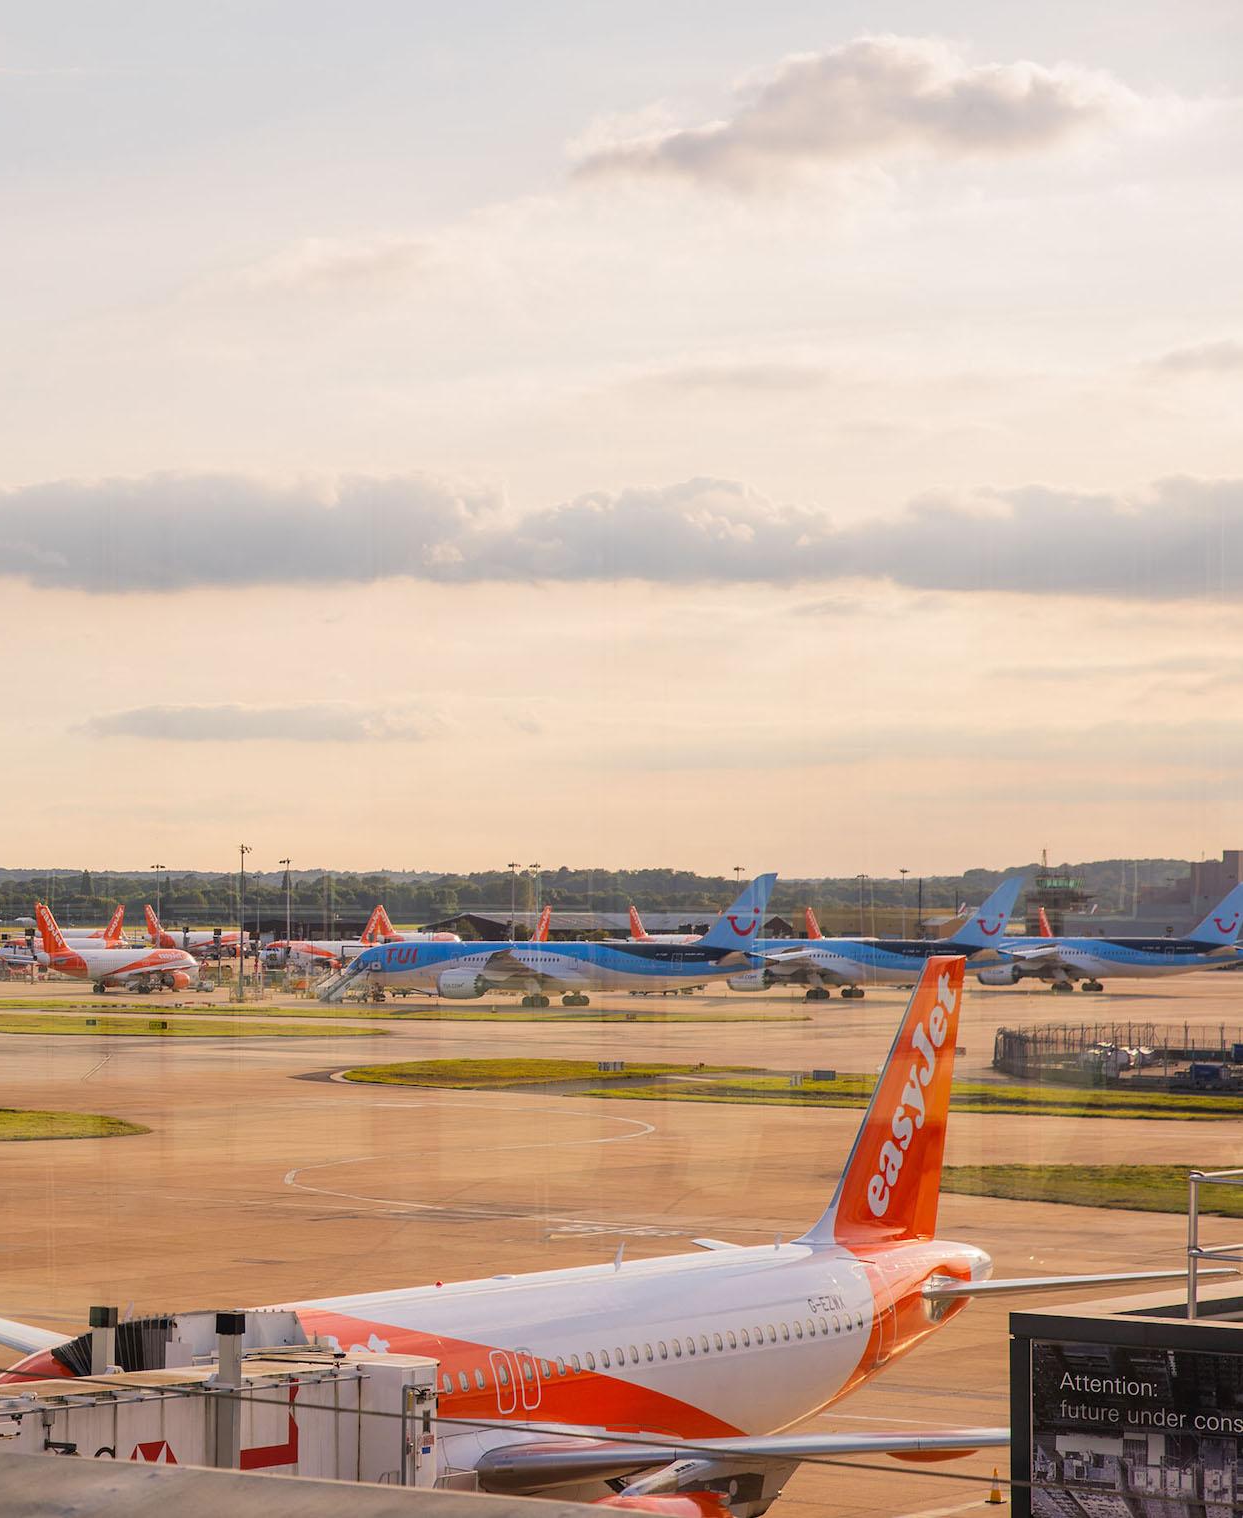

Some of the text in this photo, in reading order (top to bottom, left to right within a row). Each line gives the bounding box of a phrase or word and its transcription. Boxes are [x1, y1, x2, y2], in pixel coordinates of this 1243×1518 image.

[386, 947, 419, 965] TUI
[868, 972, 956, 1217] easyJet
[1059, 1372, 1158, 1397] Attention:
[1059, 1400, 1120, 1422] future
[1127, 1408, 1187, 1428] under
